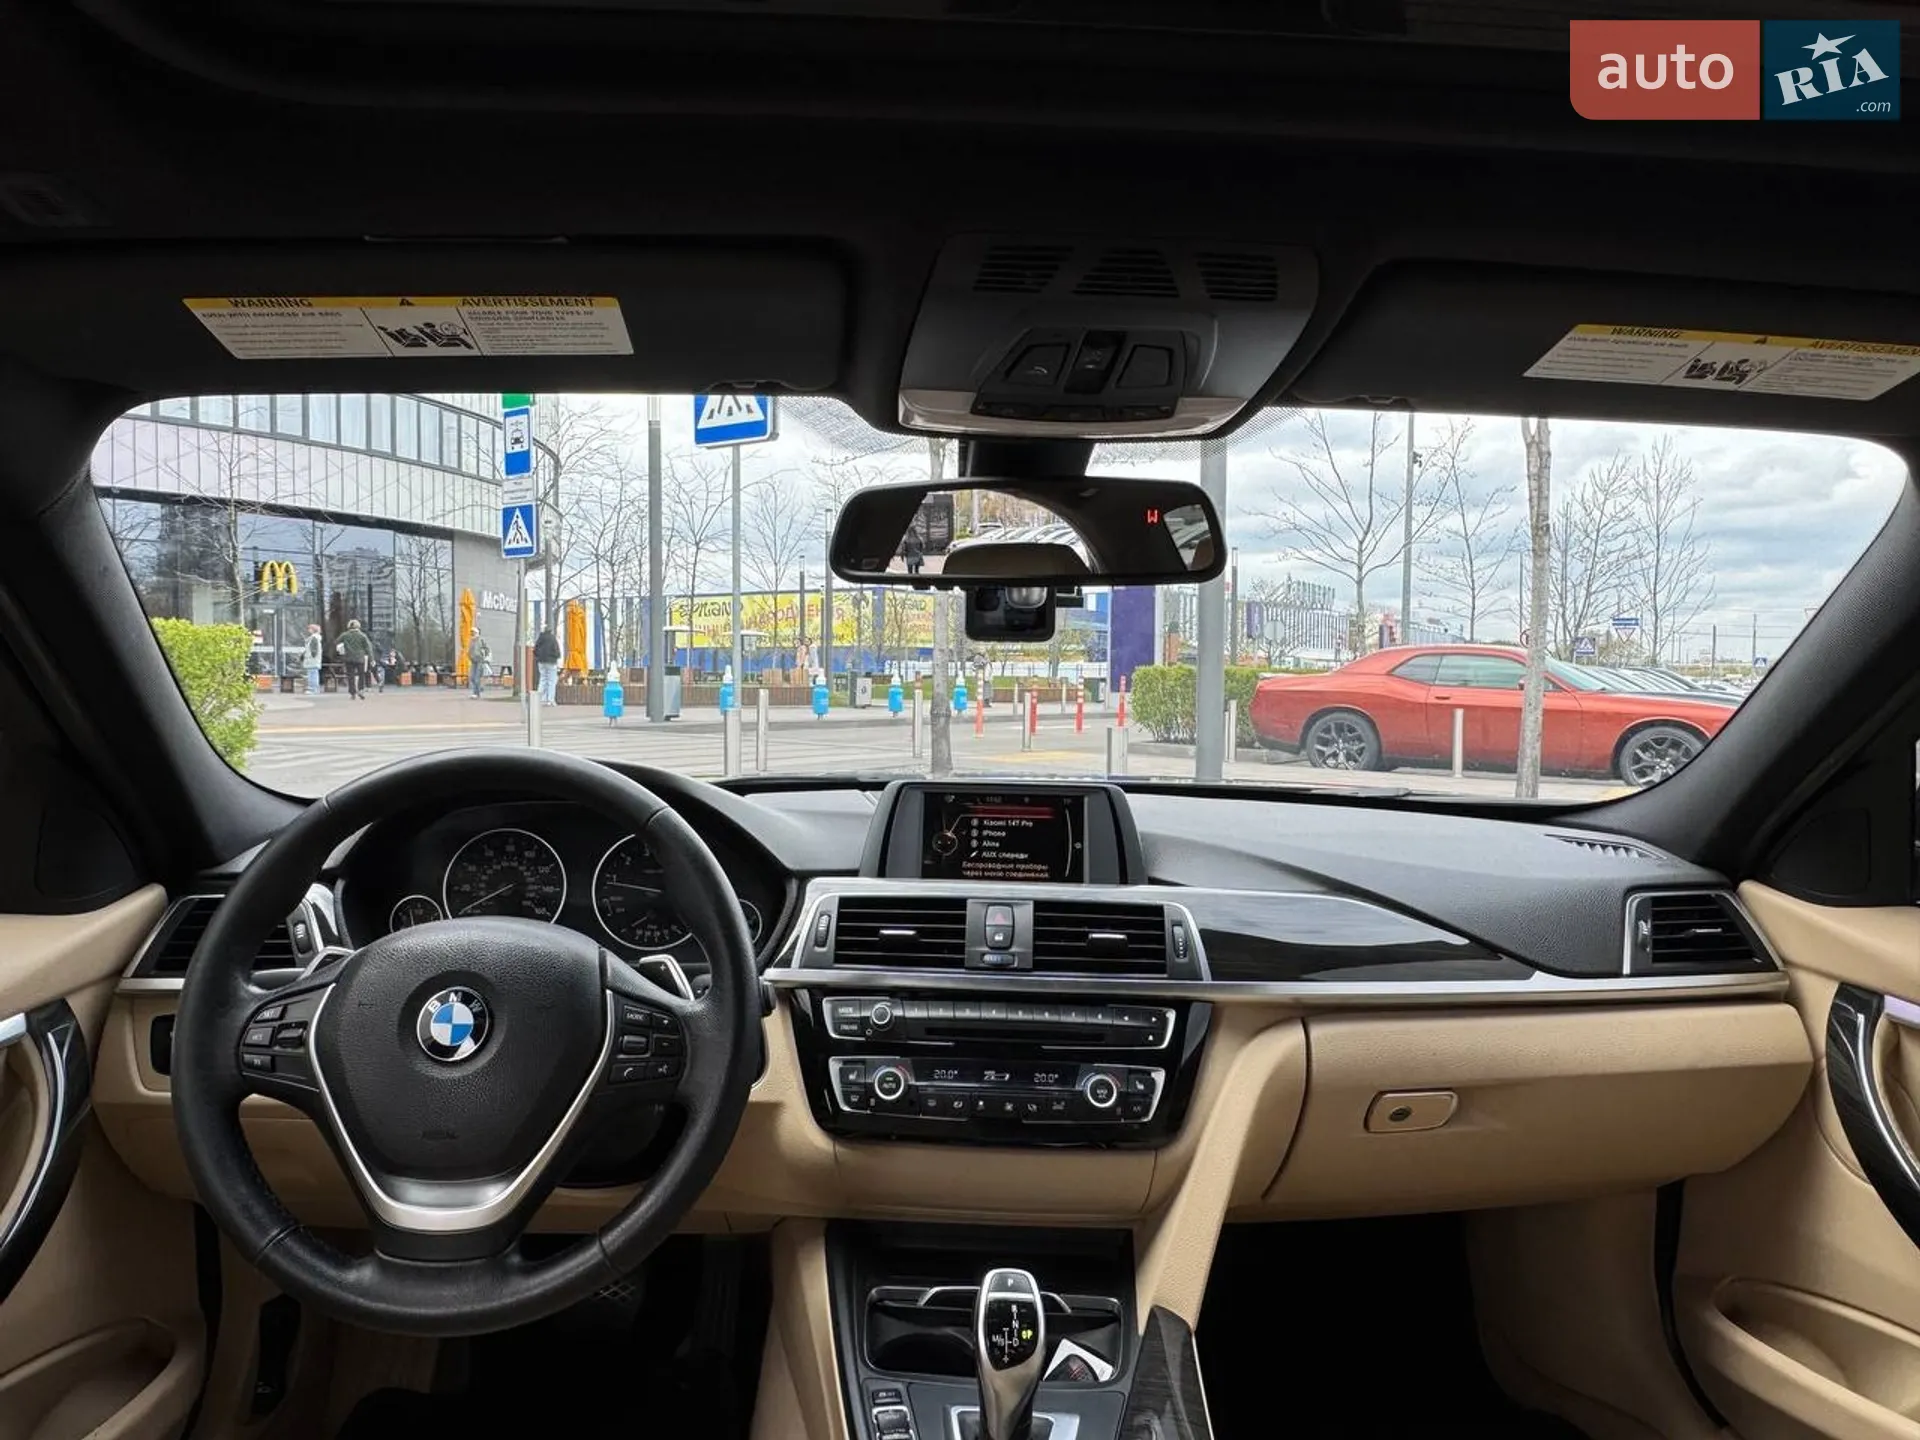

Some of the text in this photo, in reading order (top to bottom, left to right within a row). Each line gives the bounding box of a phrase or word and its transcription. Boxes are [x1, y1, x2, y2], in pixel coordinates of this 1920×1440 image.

[228, 297, 314, 308] WARNING
[461, 296, 595, 308] AVERTISSEMENT
[1610, 326, 1682, 339] WARNING
[1147, 509, 1158, 524] W
[427, 991, 483, 1013] BMW
[1007, 1278, 1014, 1286] P
[1012, 1319, 1019, 1329] N
[1012, 1338, 1020, 1347] D
